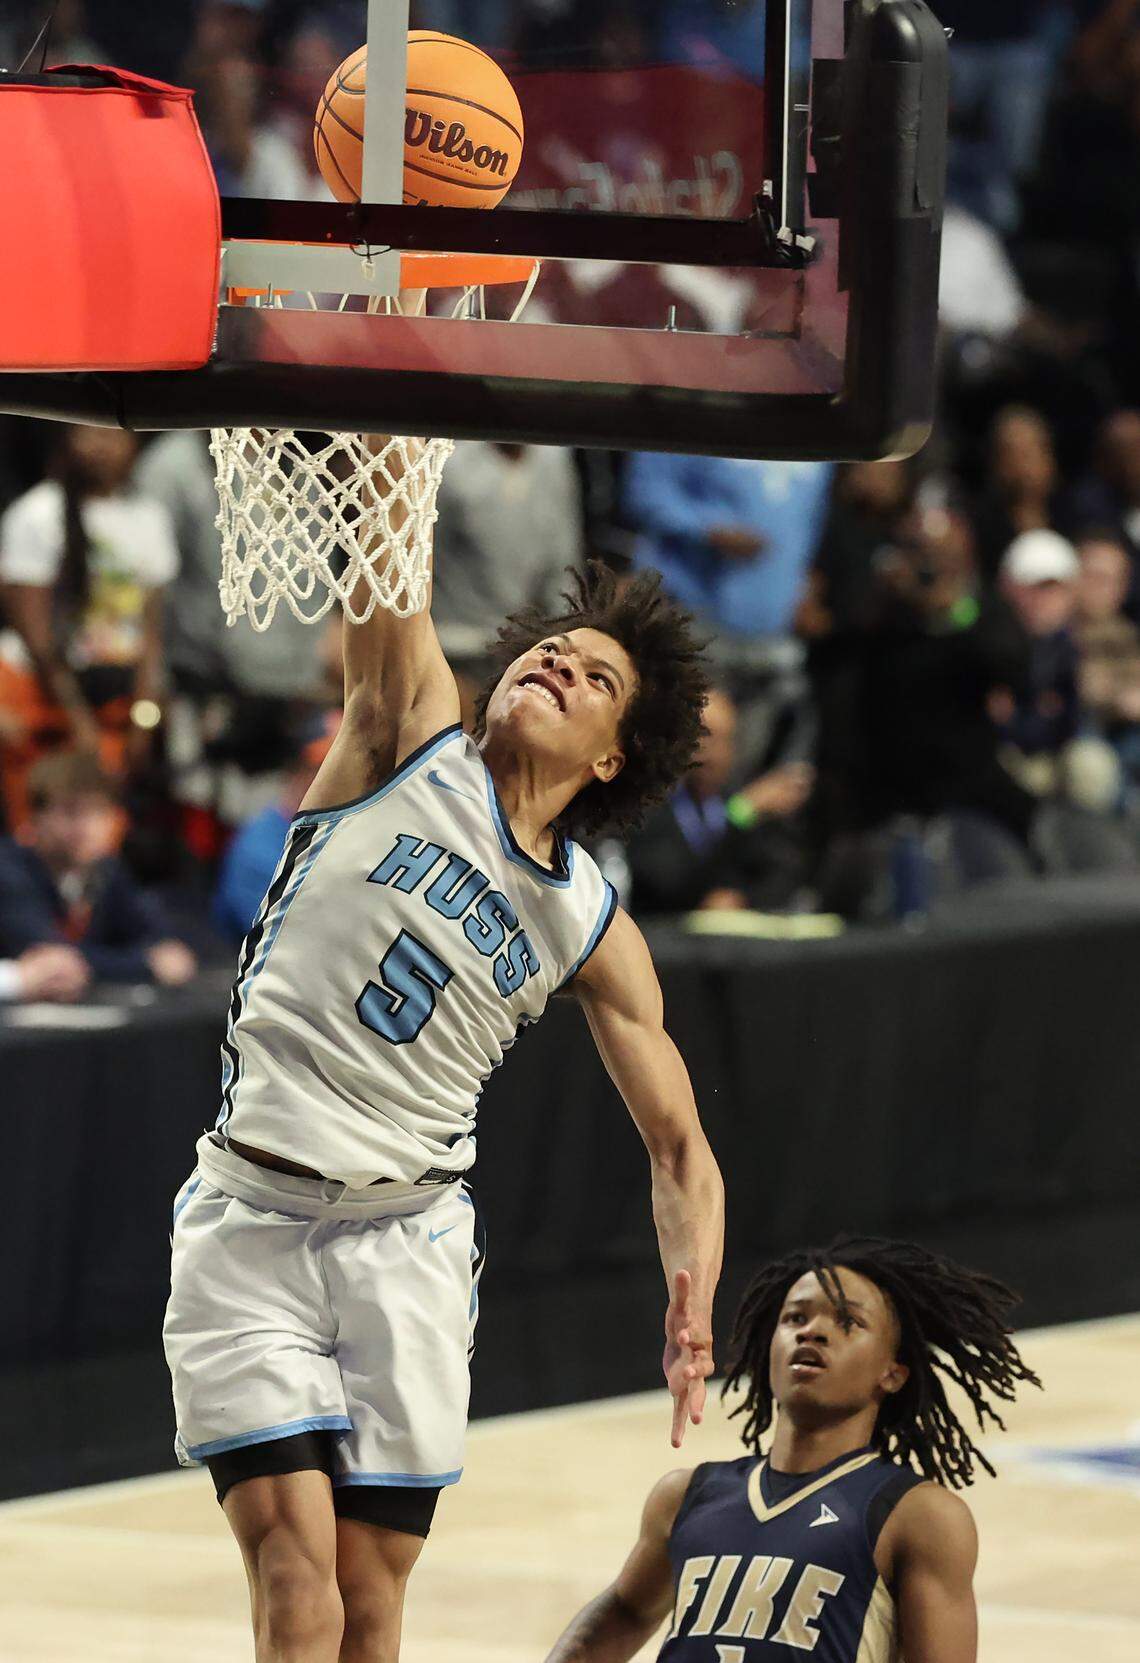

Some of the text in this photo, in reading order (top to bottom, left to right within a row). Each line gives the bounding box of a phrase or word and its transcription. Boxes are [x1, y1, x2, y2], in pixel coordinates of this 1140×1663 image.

[366, 833, 541, 998] HUSS
[354, 927, 456, 1046] 5
[668, 1555, 846, 1651] FIKE
